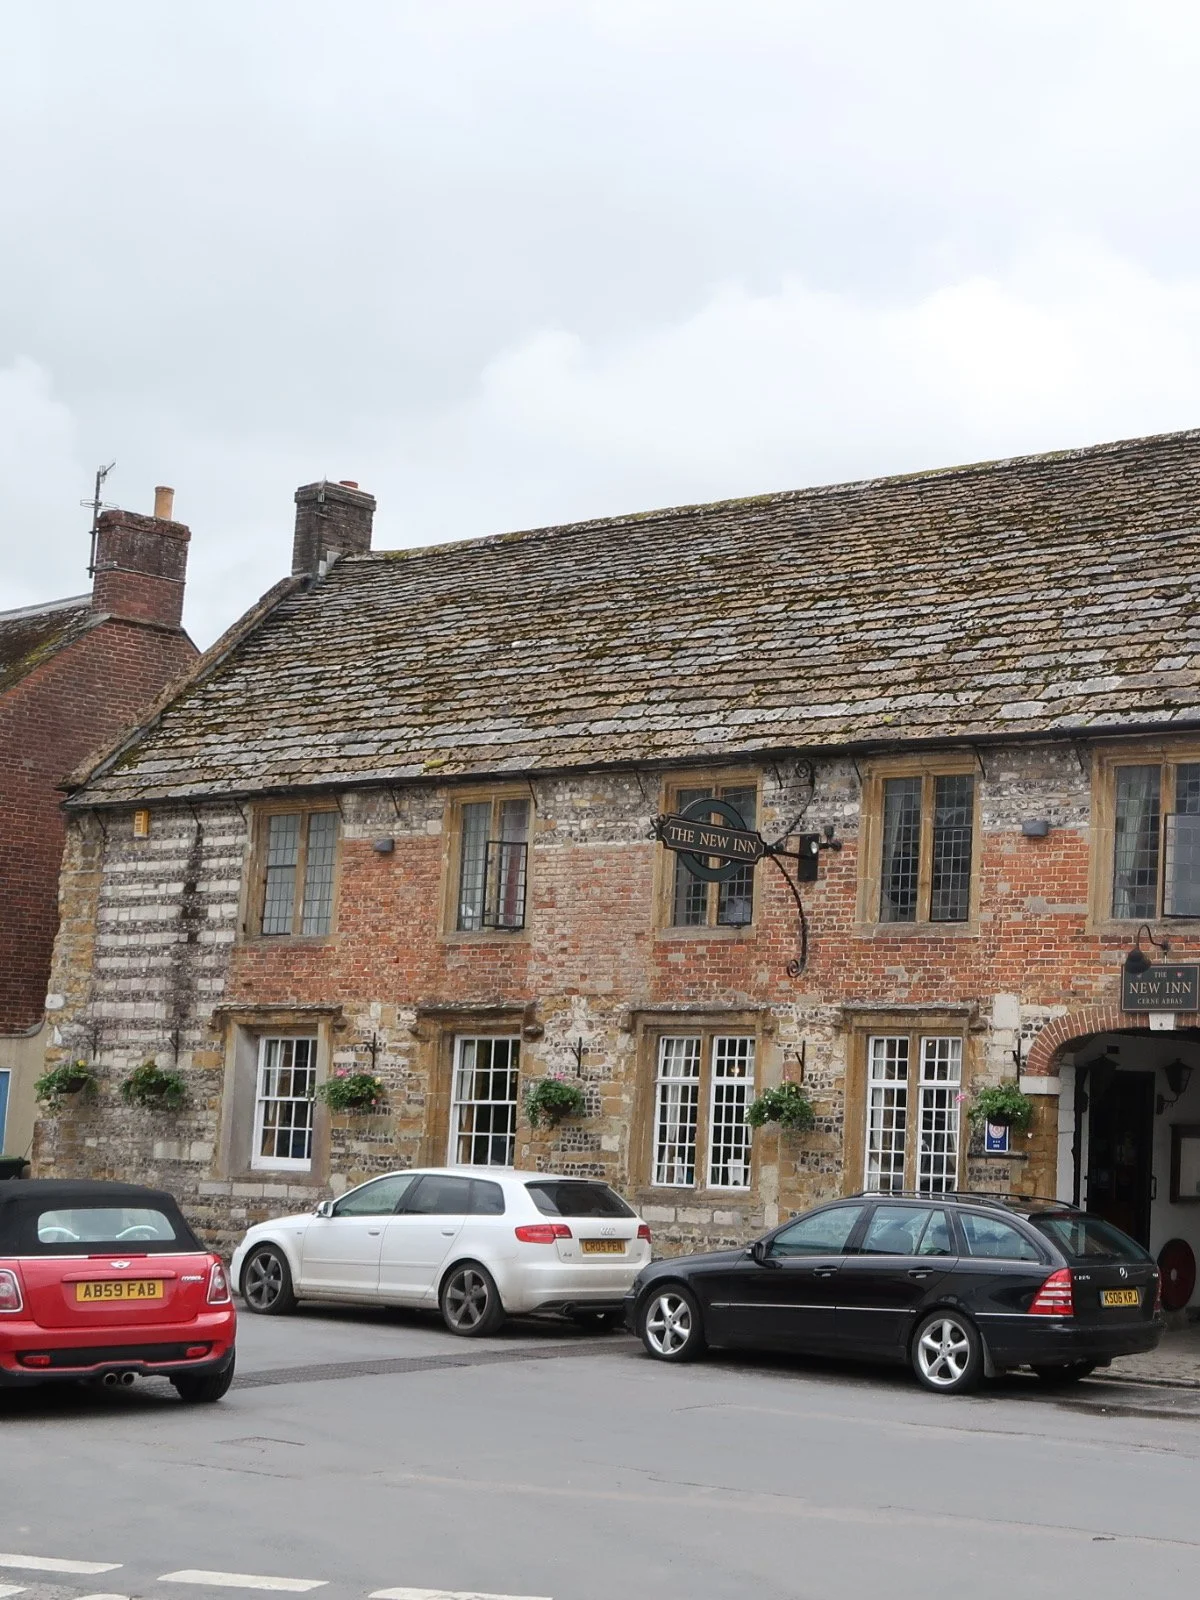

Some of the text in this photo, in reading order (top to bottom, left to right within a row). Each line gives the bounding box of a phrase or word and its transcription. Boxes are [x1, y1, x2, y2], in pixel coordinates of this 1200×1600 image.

[670, 827, 757, 854] THE NEW INN
[1129, 981, 1192, 994] NEW INN
[83, 1282, 156, 1298] AB59 FAB
[1104, 1291, 1123, 1304] KS06
